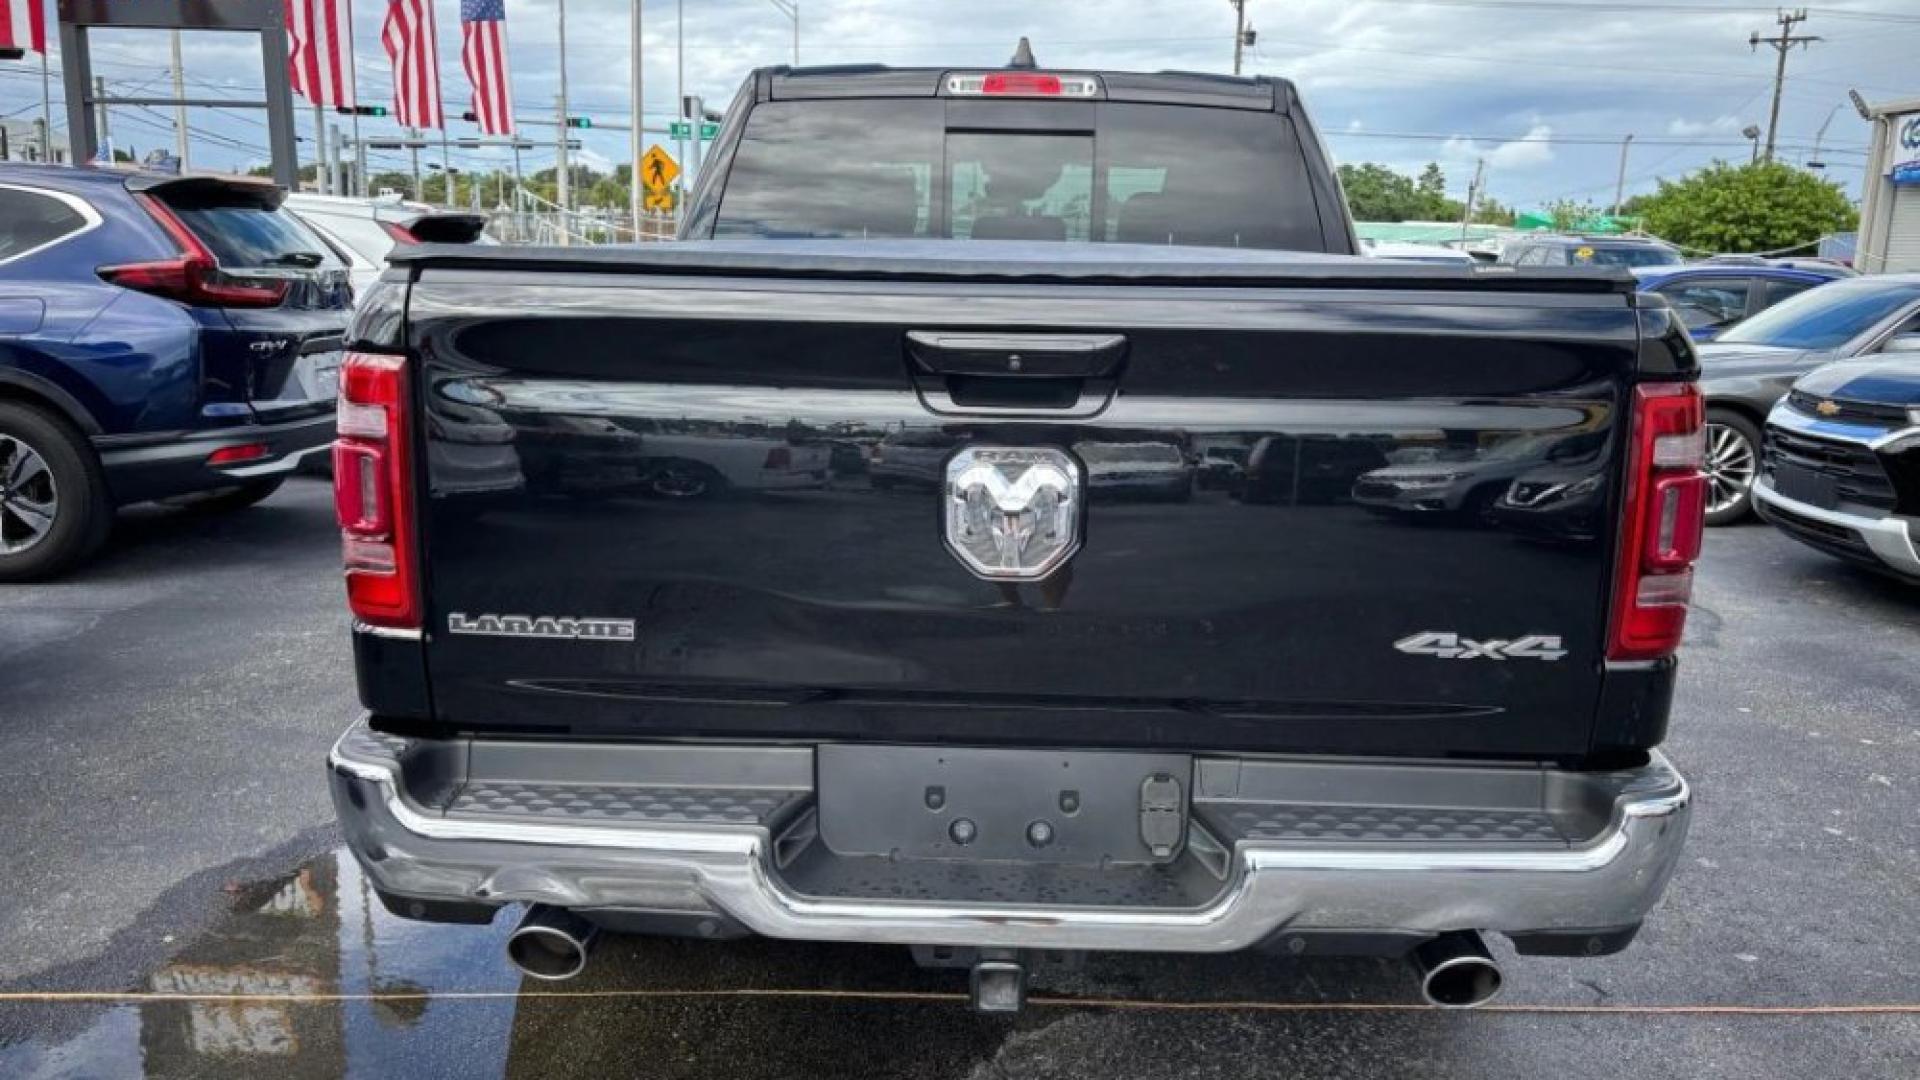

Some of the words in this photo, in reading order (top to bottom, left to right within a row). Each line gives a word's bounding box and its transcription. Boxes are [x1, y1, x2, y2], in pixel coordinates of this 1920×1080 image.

[975, 450, 1053, 464] RAM
[448, 612, 636, 641] LARAMIE
[1393, 631, 1569, 661] 4x4
